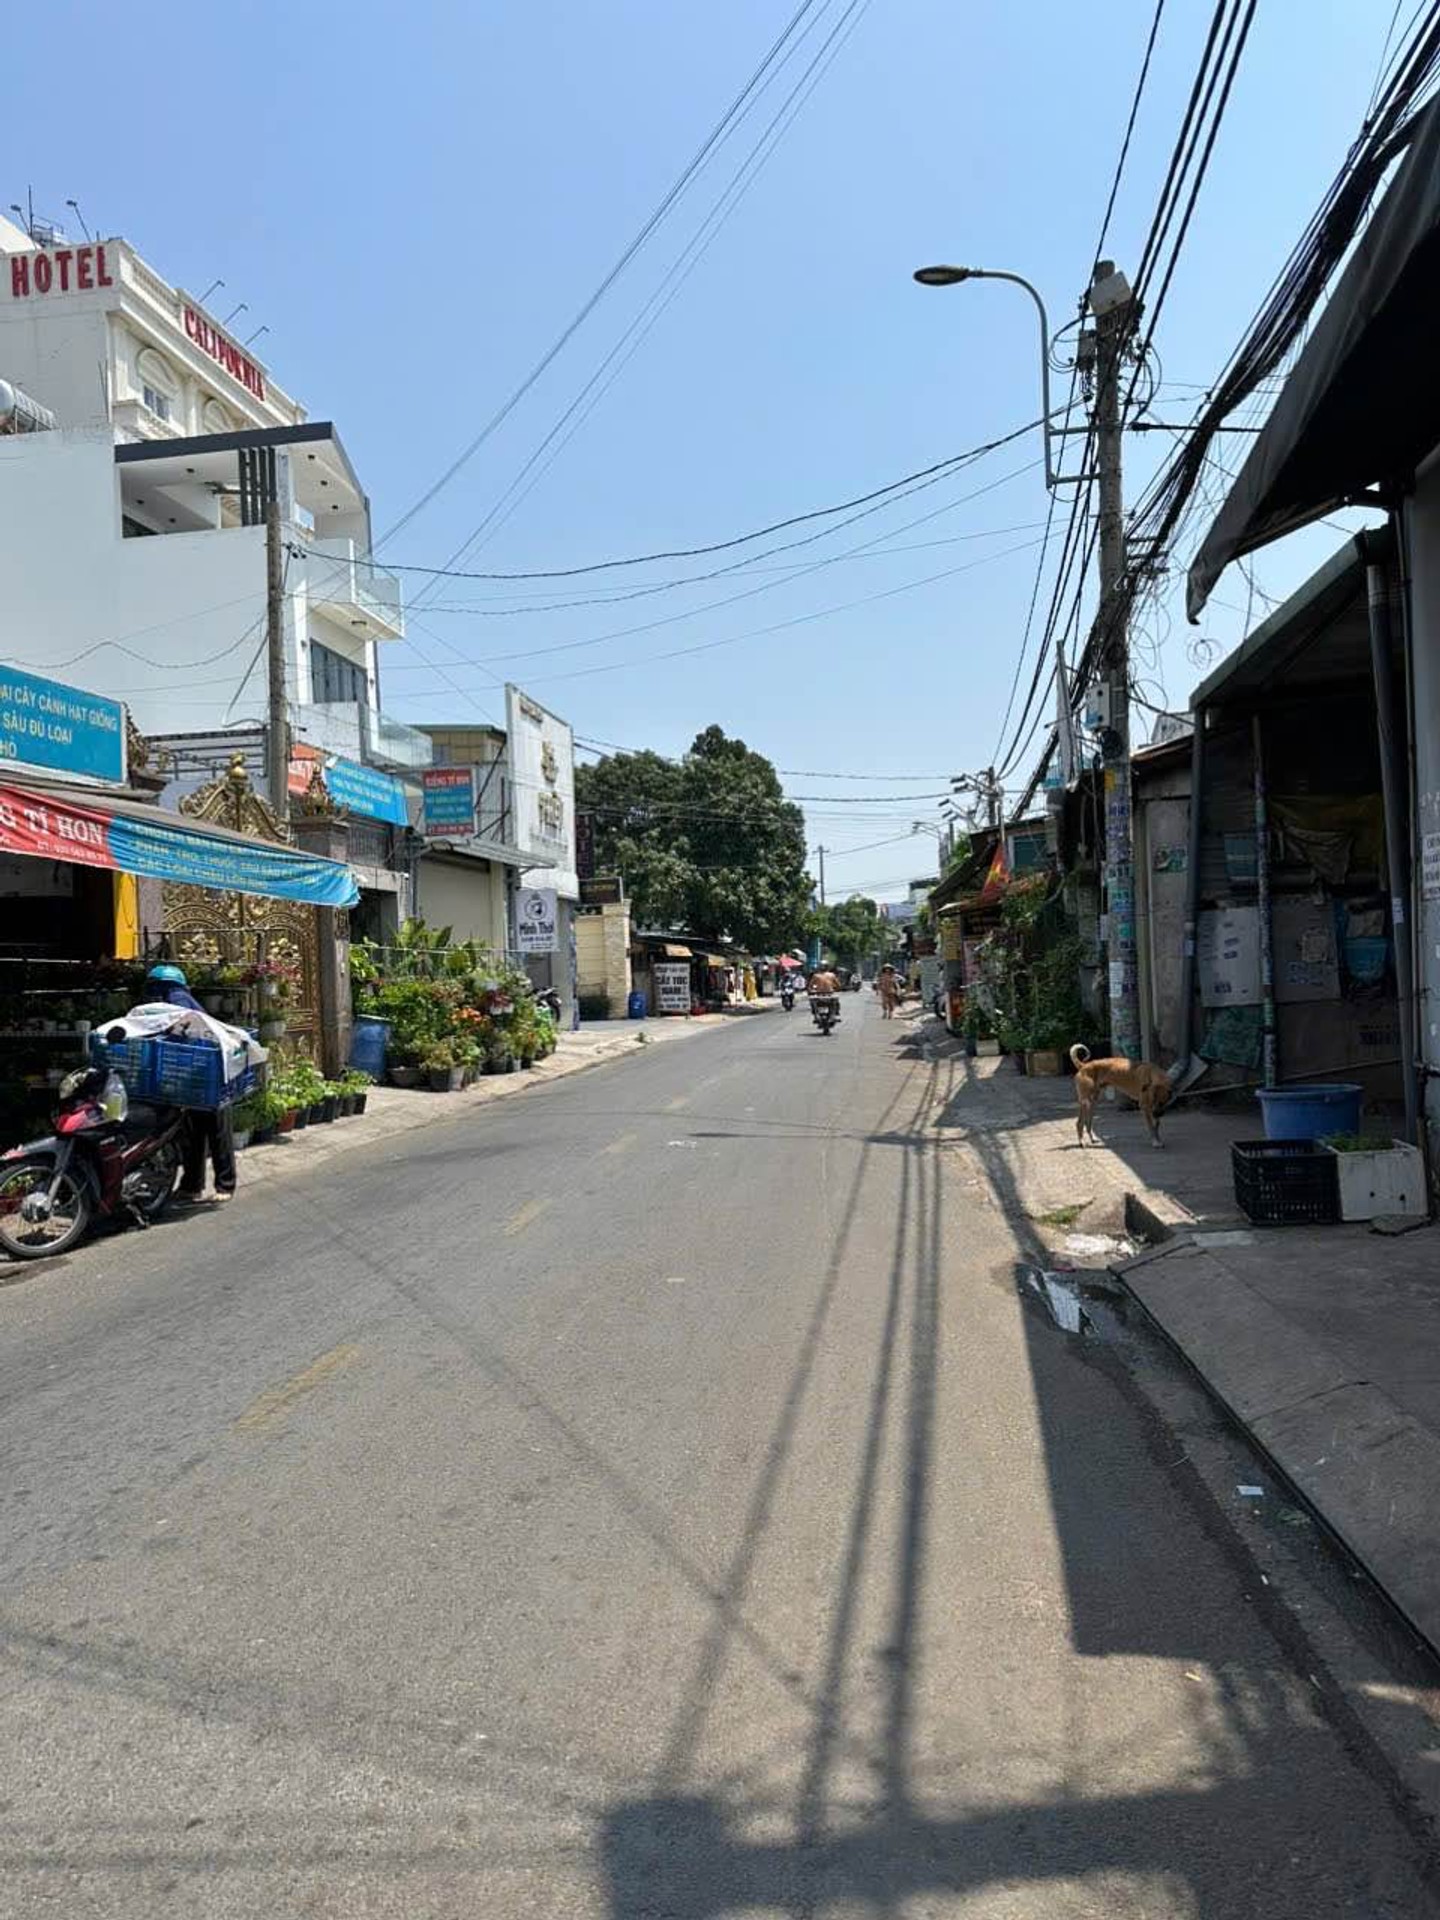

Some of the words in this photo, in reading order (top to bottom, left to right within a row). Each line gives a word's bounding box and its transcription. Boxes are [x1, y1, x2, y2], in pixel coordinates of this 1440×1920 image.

[11, 245, 113, 298] HOTEL
[184, 307, 265, 402] CALIFORNIA
[24, 805, 49, 835] TÍ
[57, 814, 103, 845] HON
